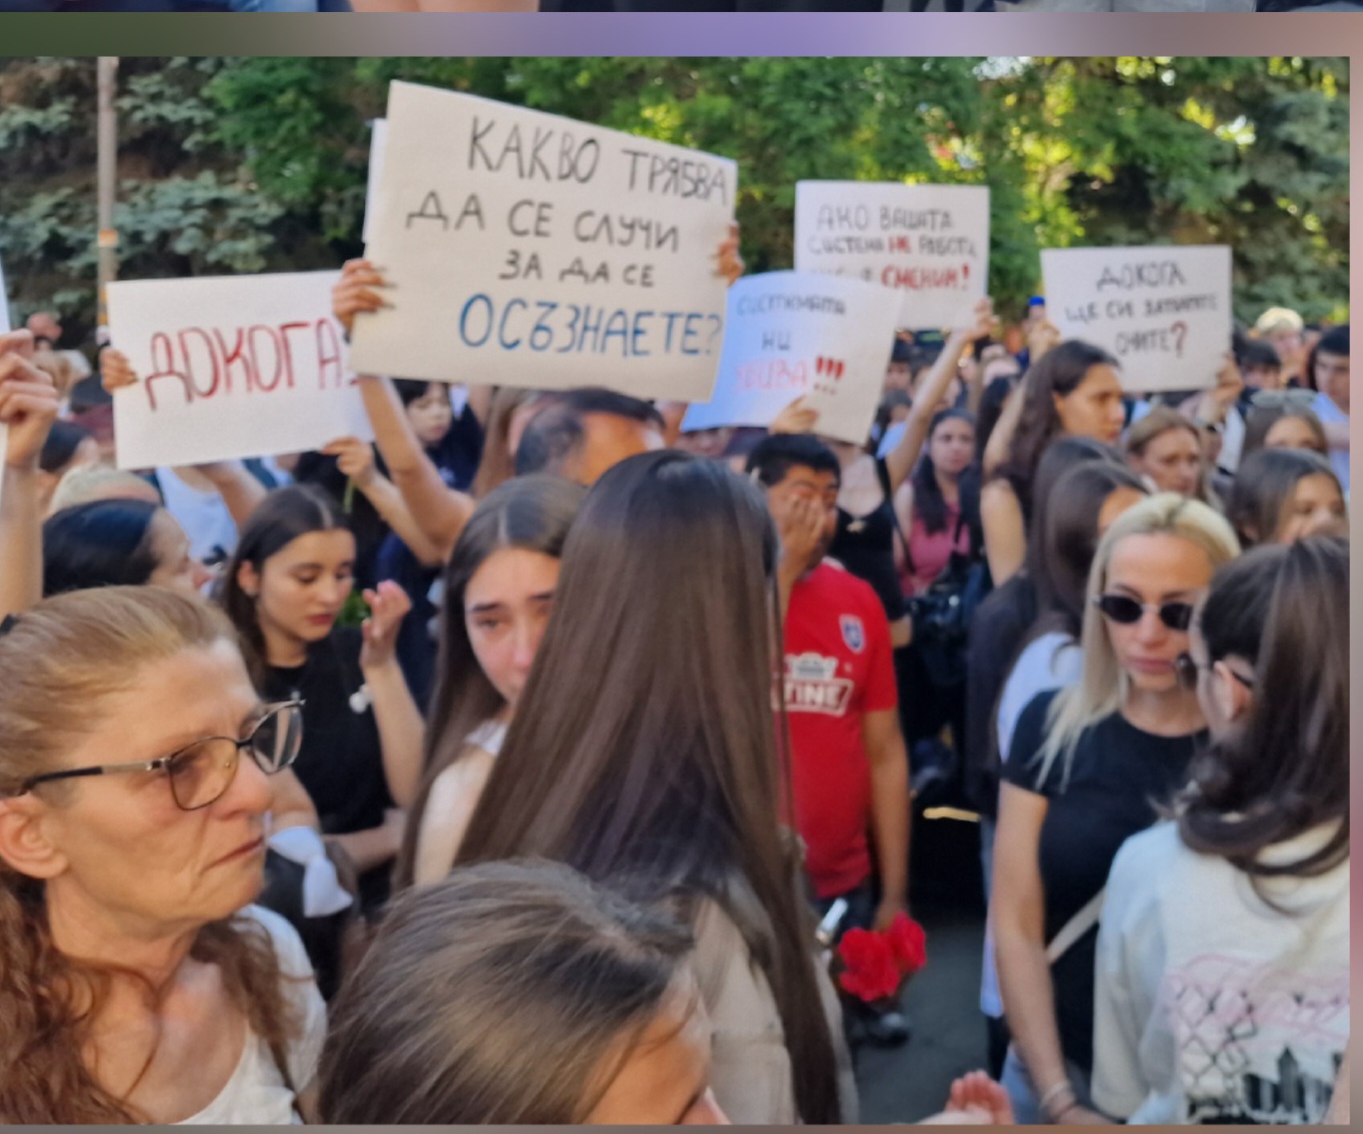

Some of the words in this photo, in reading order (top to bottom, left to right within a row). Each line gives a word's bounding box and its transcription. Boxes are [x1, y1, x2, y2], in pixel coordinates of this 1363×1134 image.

[467, 115, 601, 184] КАКВО
[621, 148, 728, 207] ТРЯБВА
[405, 190, 485, 231] ДА
[507, 199, 554, 238] СЕ
[573, 210, 680, 254] СЛУЧИ
[817, 204, 867, 230] АКО
[498, 249, 543, 280] ЗА
[559, 257, 610, 284] ДА
[623, 265, 655, 287] СЕ
[1097, 260, 1186, 291] ДОКОГА
[459, 293, 723, 358] ОСЪЗНАЕТЕ?
[144, 318, 359, 411] ДОКОГА
